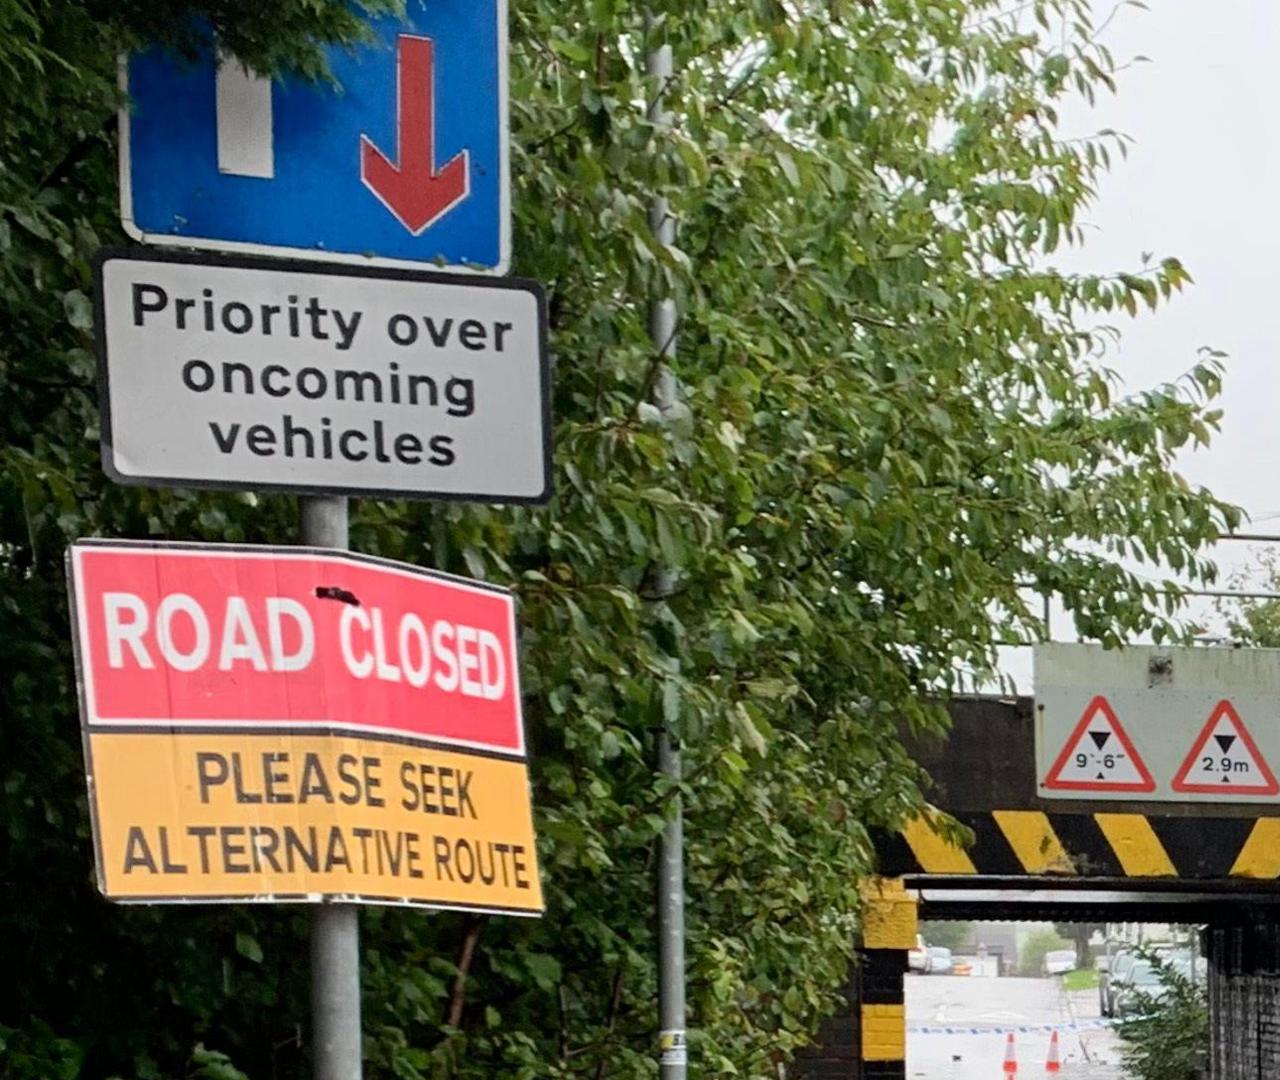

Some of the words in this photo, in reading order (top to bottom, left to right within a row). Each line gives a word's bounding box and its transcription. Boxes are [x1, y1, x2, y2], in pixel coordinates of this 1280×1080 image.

[132, 282, 363, 351] Priority
[386, 312, 513, 354] over
[181, 357, 476, 418] oncoming
[209, 414, 456, 467] vehicles
[101, 592, 317, 674] ROAD
[338, 603, 506, 701] CLOSED
[195, 751, 386, 807] PLEASE
[400, 760, 478, 820] SEEK
[1202, 756, 1249, 773] 2.9m
[123, 825, 425, 880] ALTERNATIVE
[434, 836, 531, 890] ROUTE
